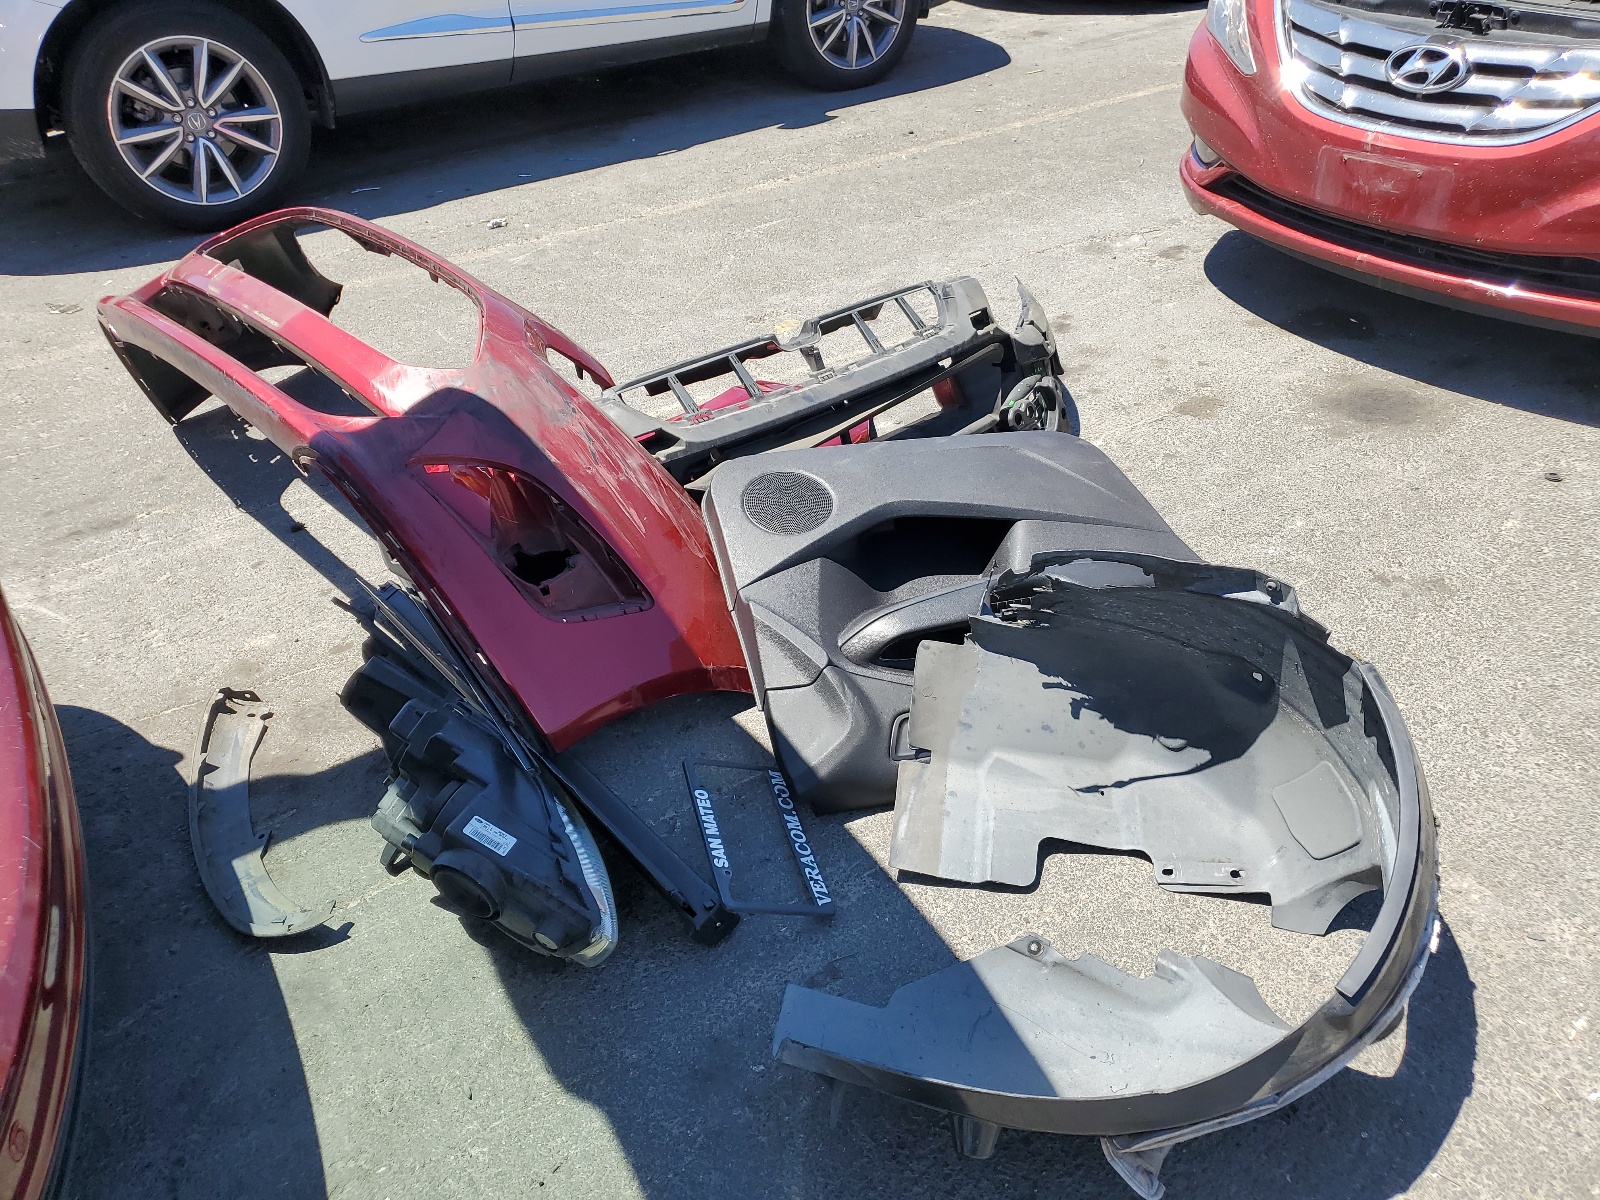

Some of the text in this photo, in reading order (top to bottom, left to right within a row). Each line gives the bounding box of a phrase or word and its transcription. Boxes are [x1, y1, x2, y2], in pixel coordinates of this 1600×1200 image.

[694, 789, 729, 868] SAN MATEO
[768, 769, 832, 907] VERACOM.COM
